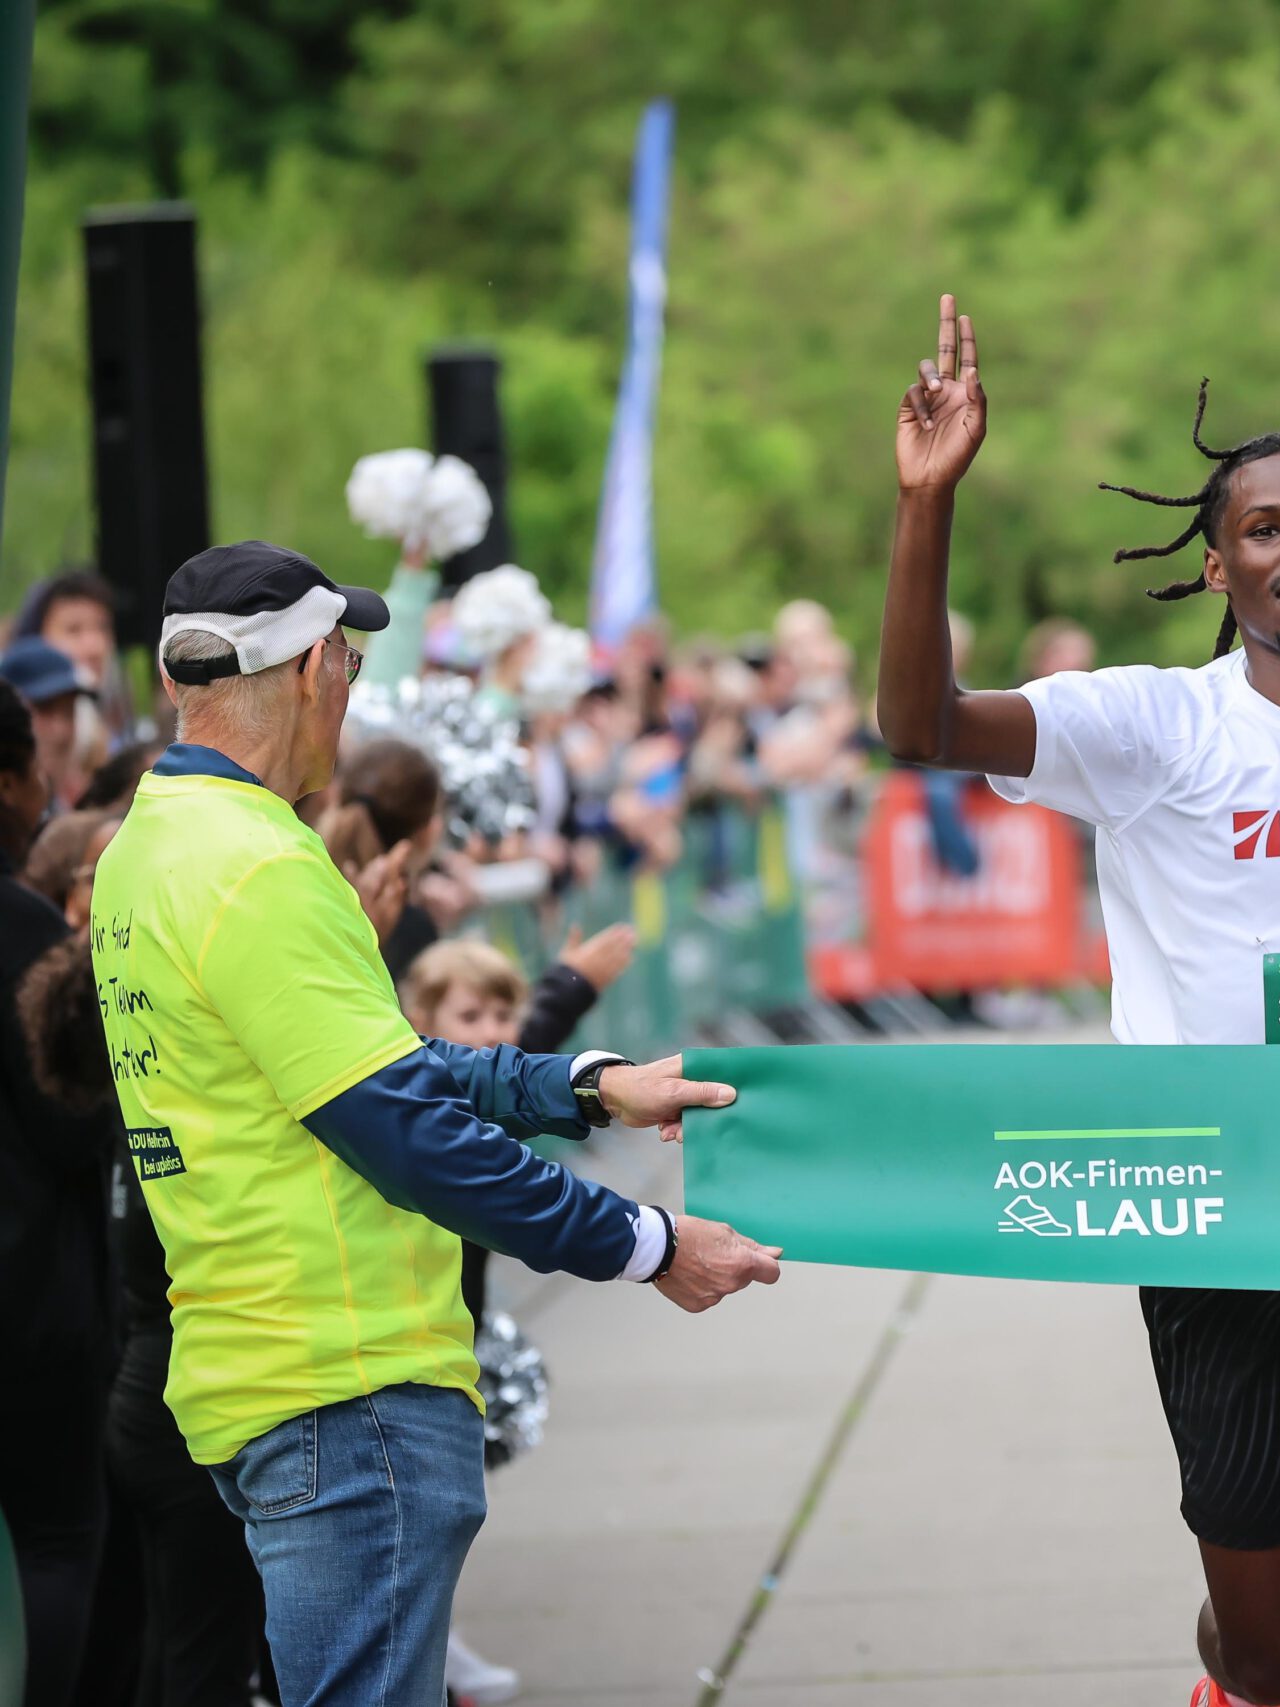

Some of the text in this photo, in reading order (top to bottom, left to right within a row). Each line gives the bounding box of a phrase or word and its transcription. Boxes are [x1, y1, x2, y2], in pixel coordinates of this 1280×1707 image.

[109, 976, 153, 1016] Team
[111, 1034, 161, 1082] hter!
[133, 1132, 147, 1149] DU
[143, 1157, 156, 1176] bei
[994, 1159, 1222, 1189] AOK-Firmen-
[1076, 1197, 1224, 1237] LAUF
